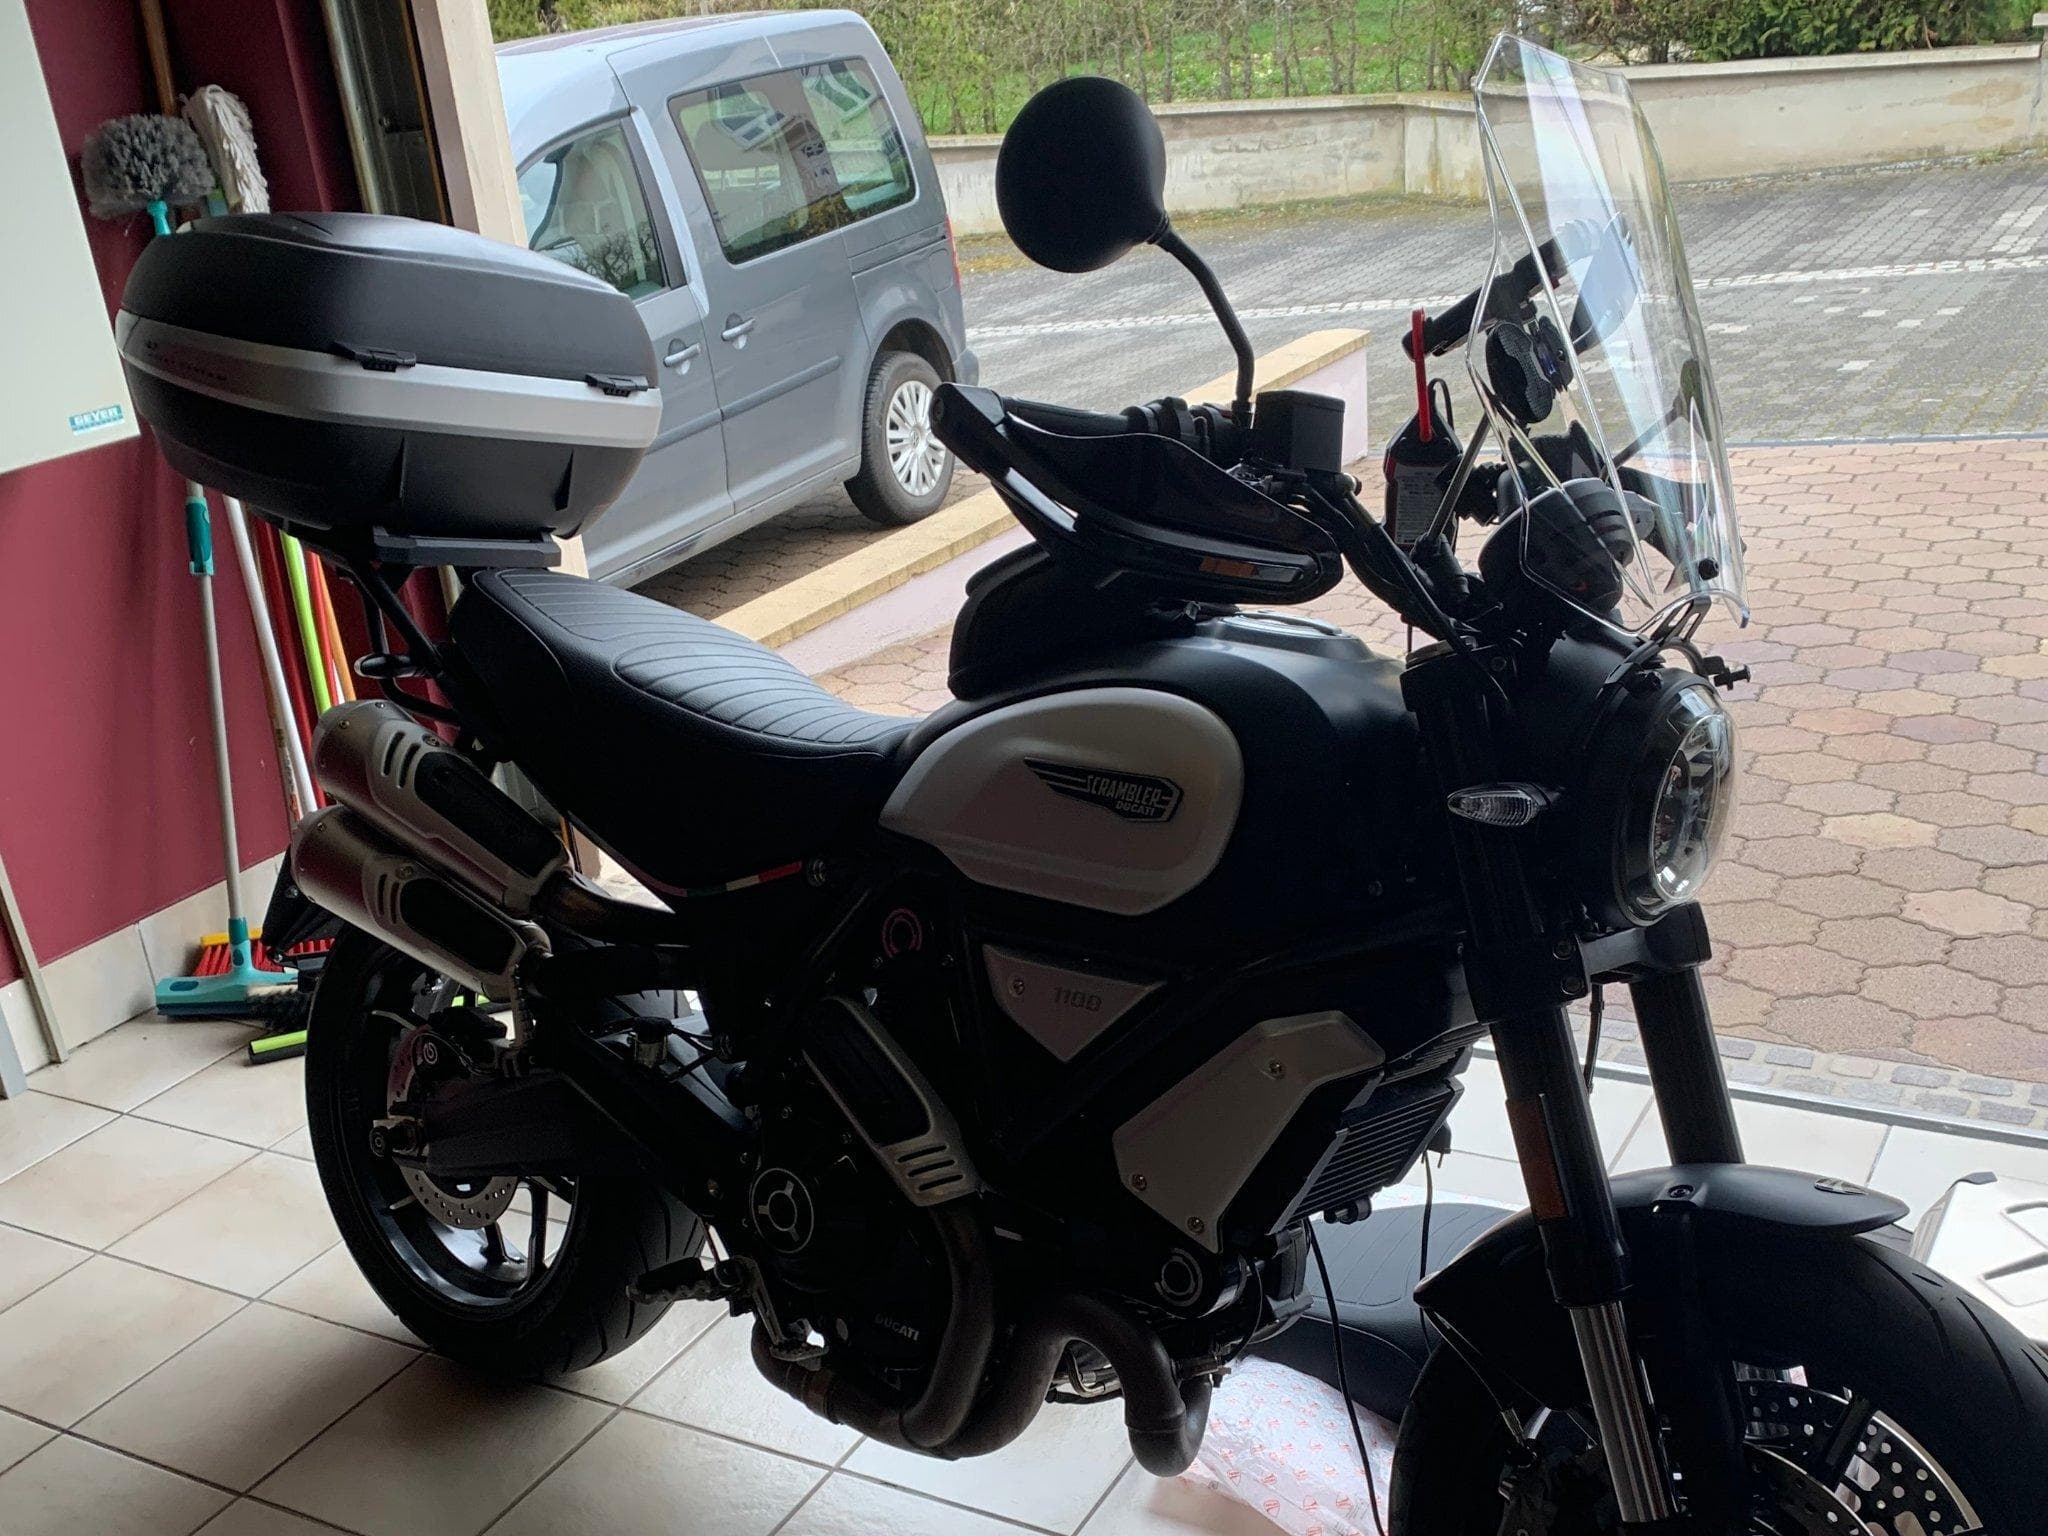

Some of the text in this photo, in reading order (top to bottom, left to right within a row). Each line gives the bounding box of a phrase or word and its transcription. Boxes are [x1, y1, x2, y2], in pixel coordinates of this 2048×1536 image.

[1086, 775, 1163, 808] SCRAMBLER
[1114, 800, 1156, 816] DUCATI
[1054, 986, 1102, 1012] 1100
[874, 1313, 920, 1341] DUCATI
